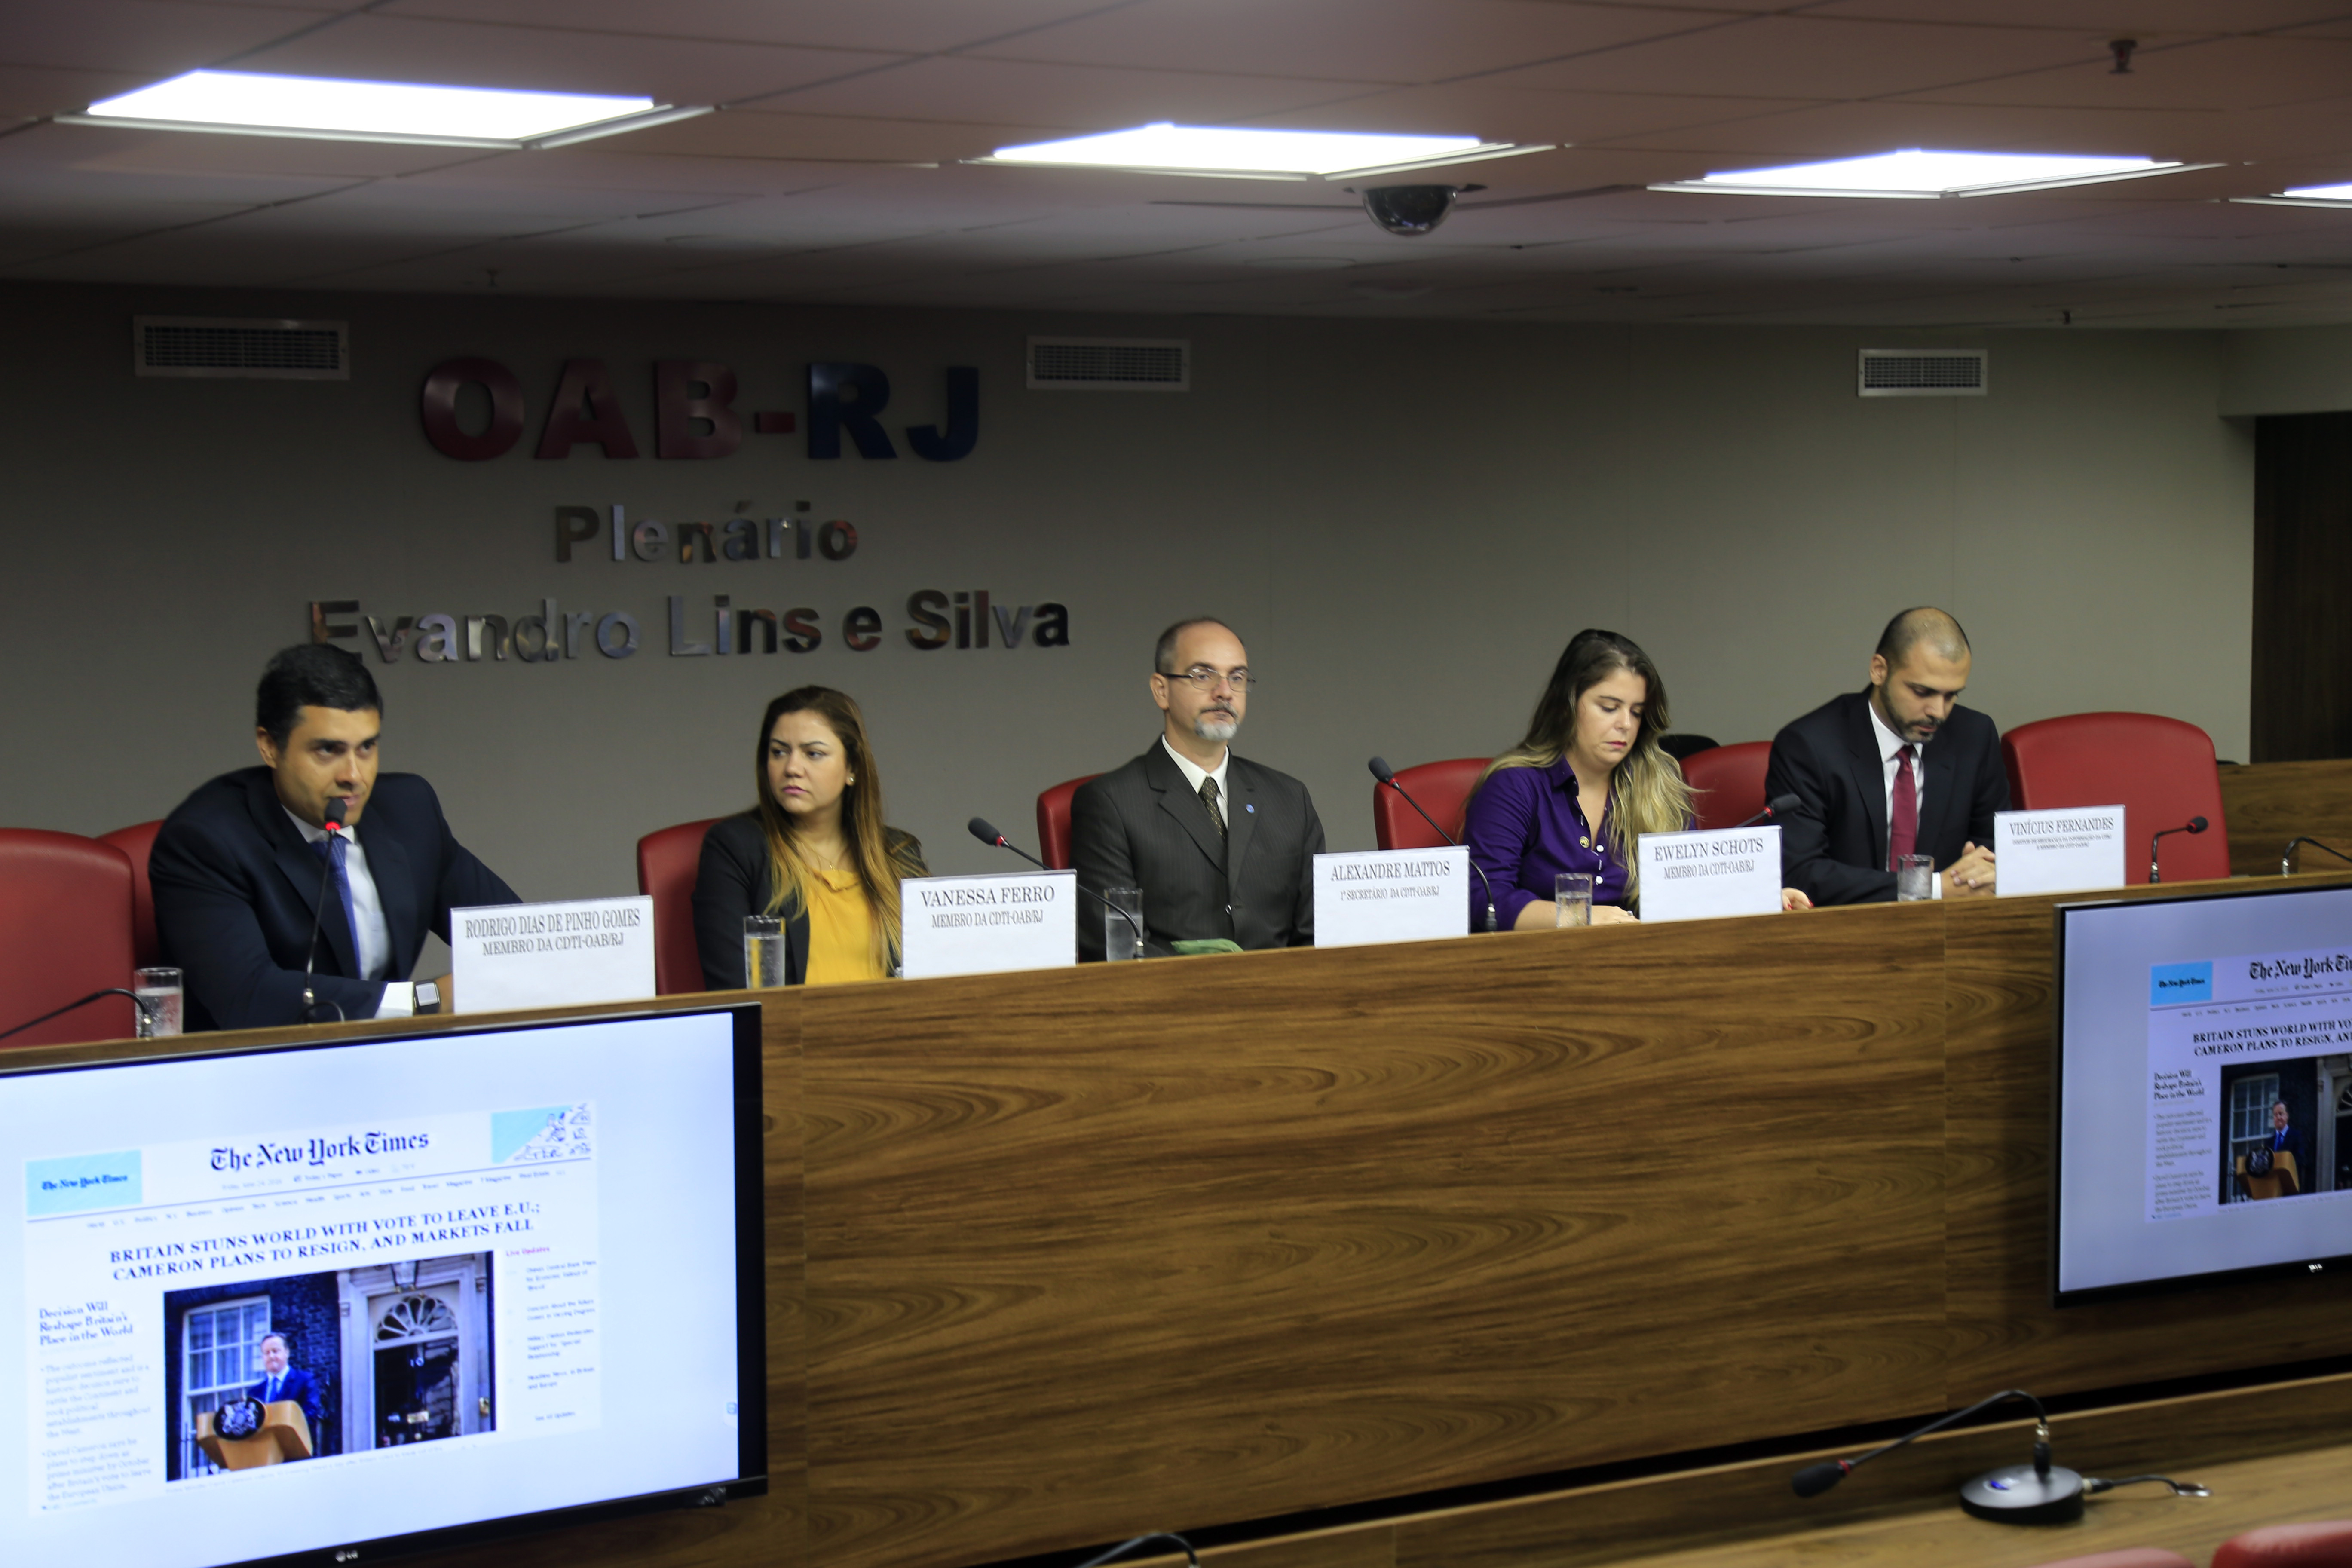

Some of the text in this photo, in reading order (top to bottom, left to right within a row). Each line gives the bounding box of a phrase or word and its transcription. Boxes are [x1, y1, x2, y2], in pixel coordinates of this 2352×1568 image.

[420, 357, 980, 461] OAB-RJ
[556, 499, 858, 563] Plenário
[309, 589, 1070, 664] Evandro Lins e Silva
[2009, 817, 2114, 836] VINÍCIUS FERNANDES
[1654, 837, 1764, 862] EWELYN SCHOTS
[1331, 860, 1451, 882] ALEXANDRE MATTOS
[1664, 864, 1697, 880] MEMBRO
[1698, 863, 1709, 876] DA
[920, 885, 1055, 908] VANESSA FERRO
[1390, 888, 1400, 899] DA
[465, 908, 640, 938] RODRIGO DIAS DE PINHO GOMES
[931, 912, 972, 928] MEMBRO
[974, 911, 987, 926] DA
[483, 939, 534, 956] MEMBRO
[537, 937, 553, 952] DA
[2250, 961, 2272, 980] The
[2275, 959, 2301, 979] New
[2303, 956, 2334, 979] York
[2193, 1029, 2234, 1044] BRITAIN
[2236, 1026, 2269, 1039] STUNS
[2271, 1023, 2307, 1035] WORLD
[2308, 1020, 2336, 1032] WITH
[2194, 1042, 2244, 1057] CAMERON
[2247, 1039, 2278, 1051] PLANS
[2280, 1038, 2293, 1047] TO
[211, 1130, 430, 1173] The New York Times
[110, 1201, 541, 1265] BRITAIN STUNS WORLD WITH VOTE TO LEAVE E.U.;
[113, 1218, 535, 1282] CAMERON PLANS TO RESIGN, AND MARKETS FALL
